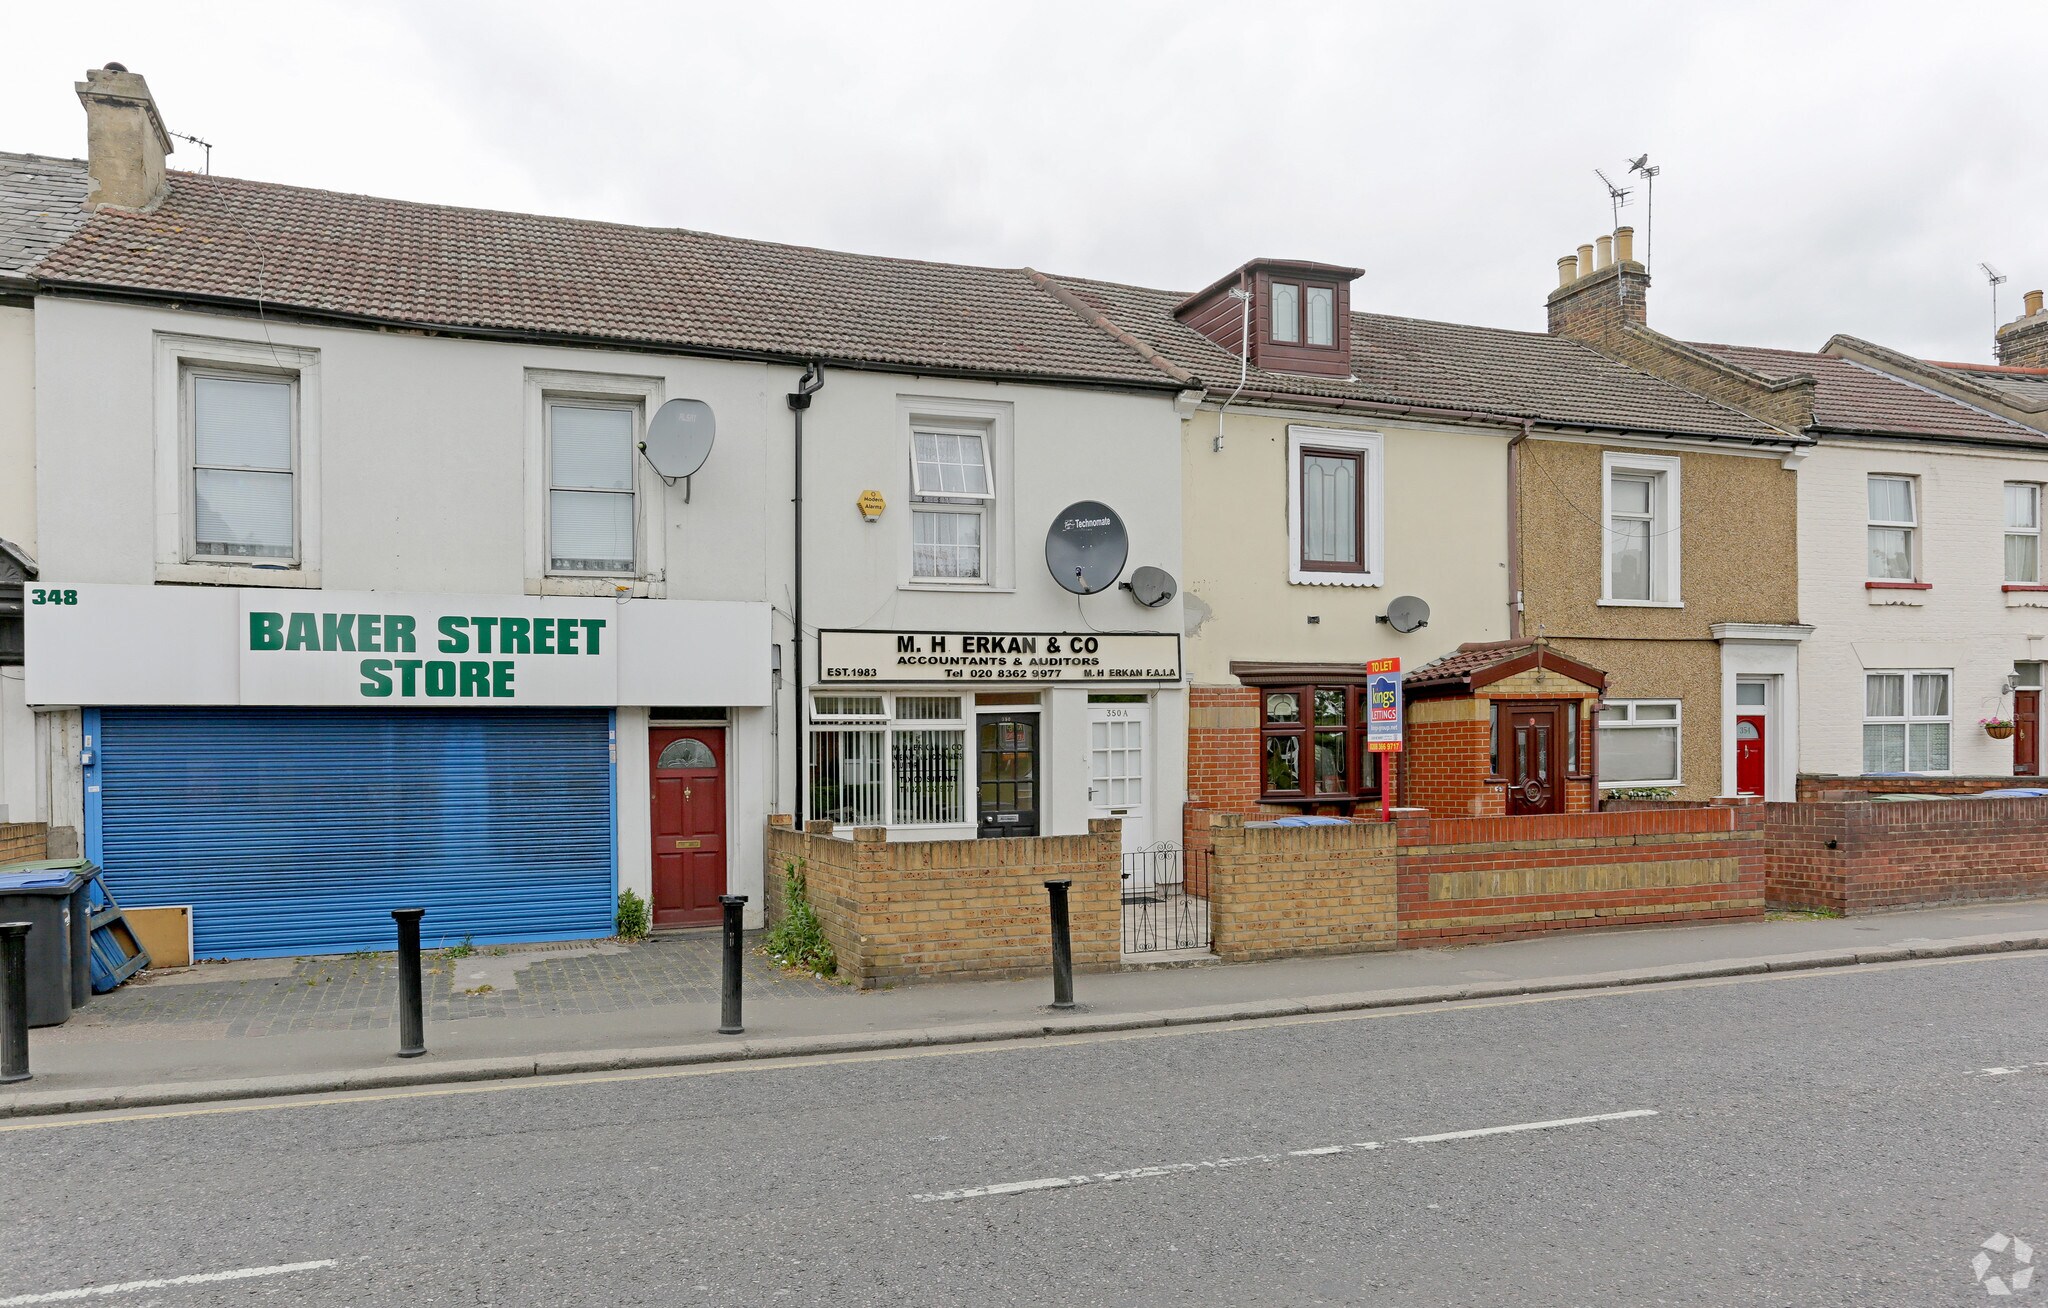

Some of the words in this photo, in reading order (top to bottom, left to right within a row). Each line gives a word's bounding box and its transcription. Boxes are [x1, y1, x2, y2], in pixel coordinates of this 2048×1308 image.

[1075, 517, 1111, 528] Technomate
[31, 589, 78, 606] 348
[249, 611, 417, 653] BAKER
[438, 615, 606, 655] STREET
[897, 635, 921, 653] M.
[962, 636, 1037, 654] ERKAN
[1047, 636, 1061, 654] &
[1070, 636, 1099, 654] CO
[897, 656, 1007, 666] ACCOUNTANTS
[1013, 657, 1023, 666] &
[1029, 657, 1099, 666] AUDITORS
[1371, 662, 1380, 673] TO
[1380, 660, 1393, 671] LET
[360, 658, 515, 697] STORE
[827, 667, 877, 677] EST.1983
[944, 668, 963, 678] Tel
[970, 669, 993, 678] 020
[997, 669, 1027, 678] 8362
[1032, 669, 1062, 678] 9977
[1109, 669, 1143, 678] ERKAN
[1372, 687, 1395, 708] kings
[1372, 709, 1396, 720] LETTINGS
